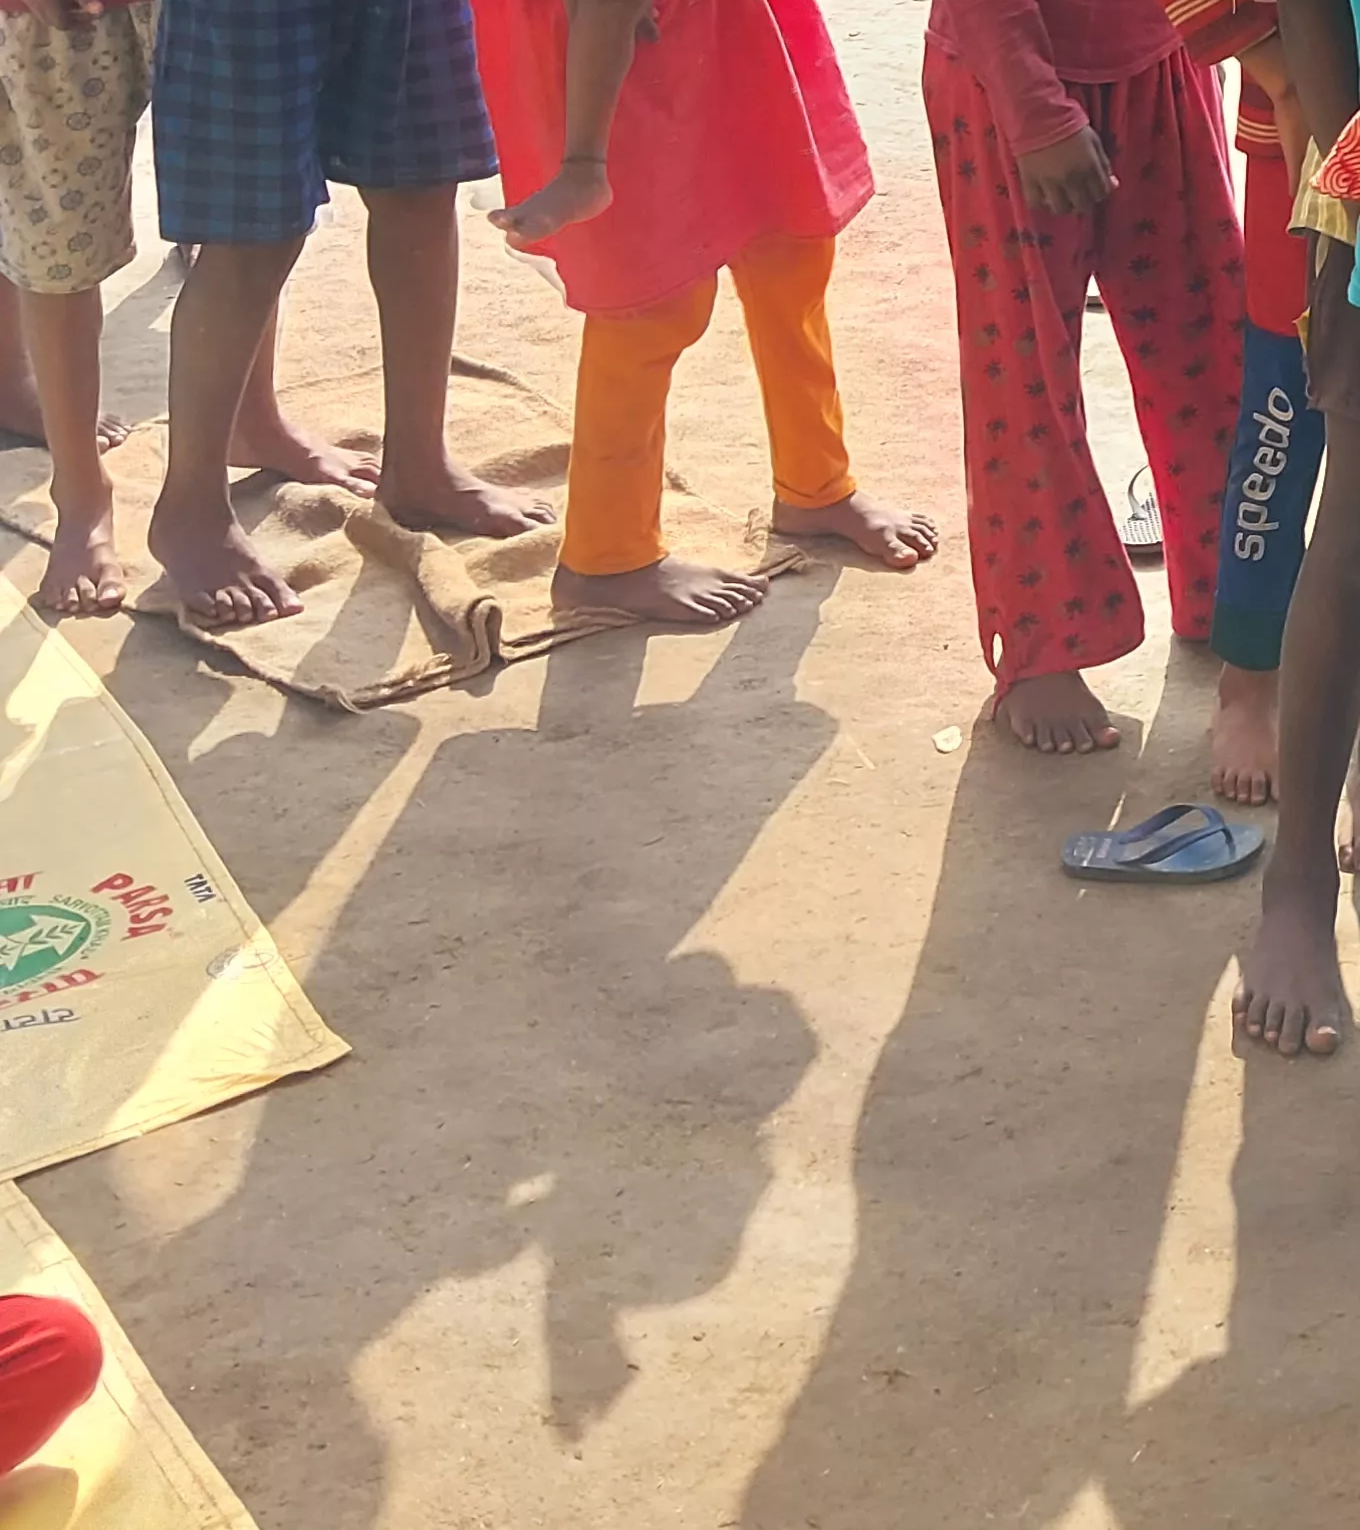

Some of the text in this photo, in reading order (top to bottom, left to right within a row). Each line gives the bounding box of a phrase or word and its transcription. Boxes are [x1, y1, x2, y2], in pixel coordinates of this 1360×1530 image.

[1234, 386, 1294, 562] speedo
[89, 872, 173, 941] PARSA
[184, 873, 217, 903] TATA
